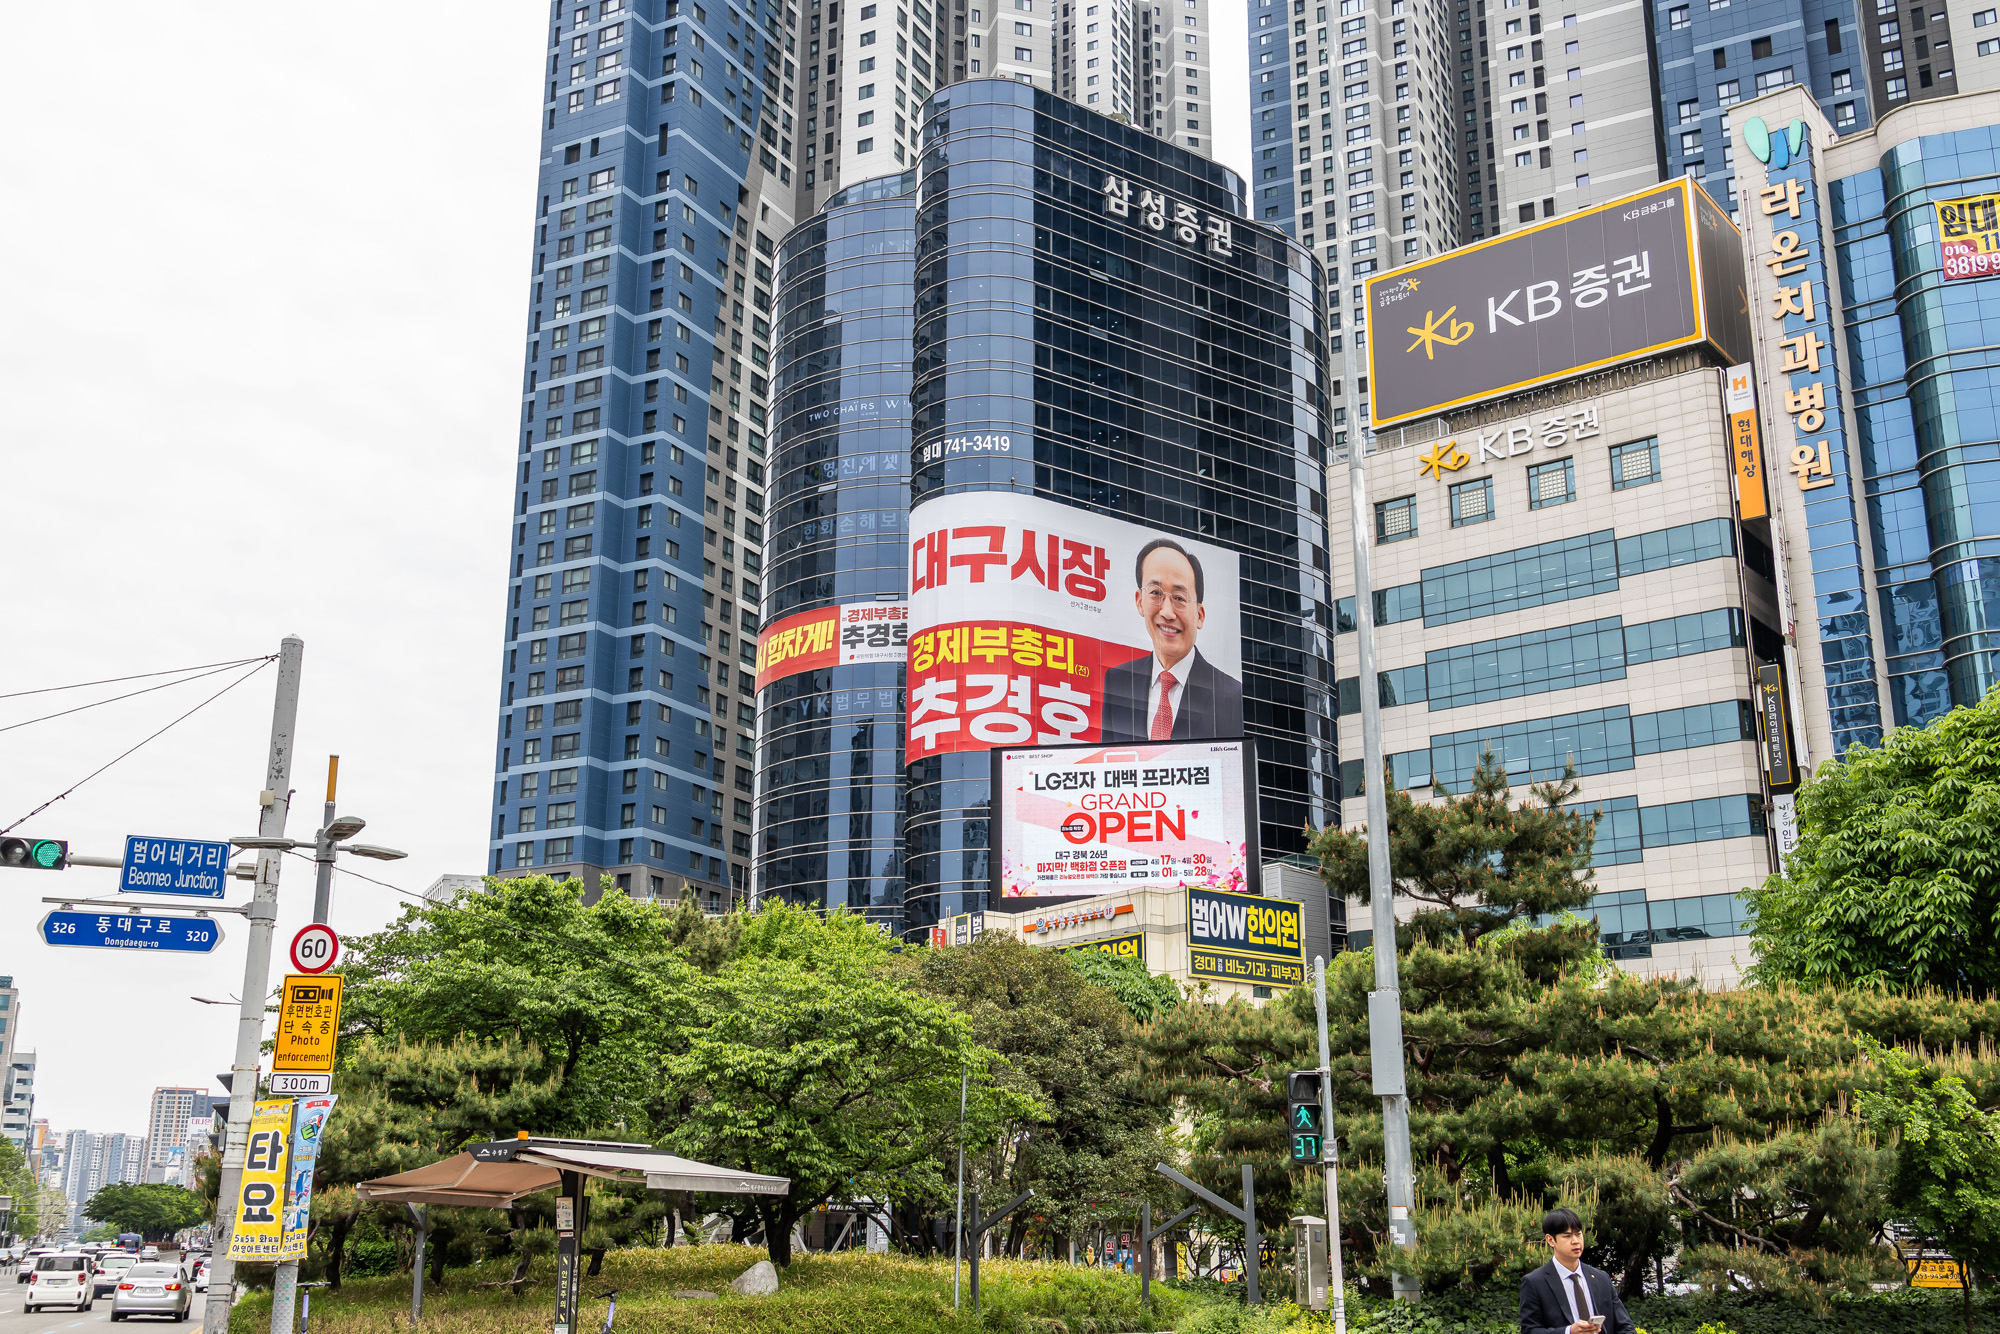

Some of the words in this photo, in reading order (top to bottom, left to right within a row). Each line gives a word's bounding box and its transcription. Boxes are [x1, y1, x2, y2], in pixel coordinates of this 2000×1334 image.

[1104, 176, 1232, 257] 삼성증권
[1940, 199, 1998, 237] 임대
[1488, 250, 1652, 333] KB증권
[1760, 178, 1835, 491] 라온치과병원
[809, 410, 829, 422] TWO
[1478, 406, 1600, 464] KB증권
[923, 441, 941, 463] 임대
[944, 434, 1010, 455] 741-3419
[1738, 419, 1756, 478] 현대해상
[823, 454, 898, 478] 영진에셋
[803, 513, 910, 540] 한화손해보
[912, 526, 1110, 602] 대구시장
[767, 619, 836, 668] 힘차게!
[913, 627, 1074, 675] 경제부총리
[910, 674, 1091, 750] 추경호
[1035, 769, 1096, 791] LG전자
[1104, 769, 1137, 788] 대백
[1143, 767, 1210, 787] 프라자점
[1081, 792, 1166, 811] GRAND
[1062, 809, 1185, 845] OPEN
[134, 840, 222, 869] 범어네거리
[1037, 862, 1067, 873] 마지막!
[1070, 861, 1097, 872] 백화점
[1100, 860, 1126, 871] 오픈점
[1056, 851, 1070, 860] 대구
[1090, 850, 1107, 859] 26년
[128, 866, 171, 887] Beomeo
[175, 869, 218, 890] Junction
[52, 922, 76, 934] 326
[96, 916, 171, 933] 동대구로
[186, 930, 209, 942] 320
[1048, 906, 1103, 930] 북창동순두부
[1191, 898, 1298, 949] 범어W한의원
[105, 936, 159, 948] Dongdaegu-ro
[301, 938, 327, 959] 60
[1194, 955, 1216, 971] 경대
[286, 1004, 332, 1018] 후면번호판
[291, 1035, 320, 1045] Photo
[278, 1052, 329, 1062] enforcement
[282, 1078, 319, 1090] 300m
[1295, 1137, 1316, 1158] 37
[259, 1234, 279, 1243] 화요일
